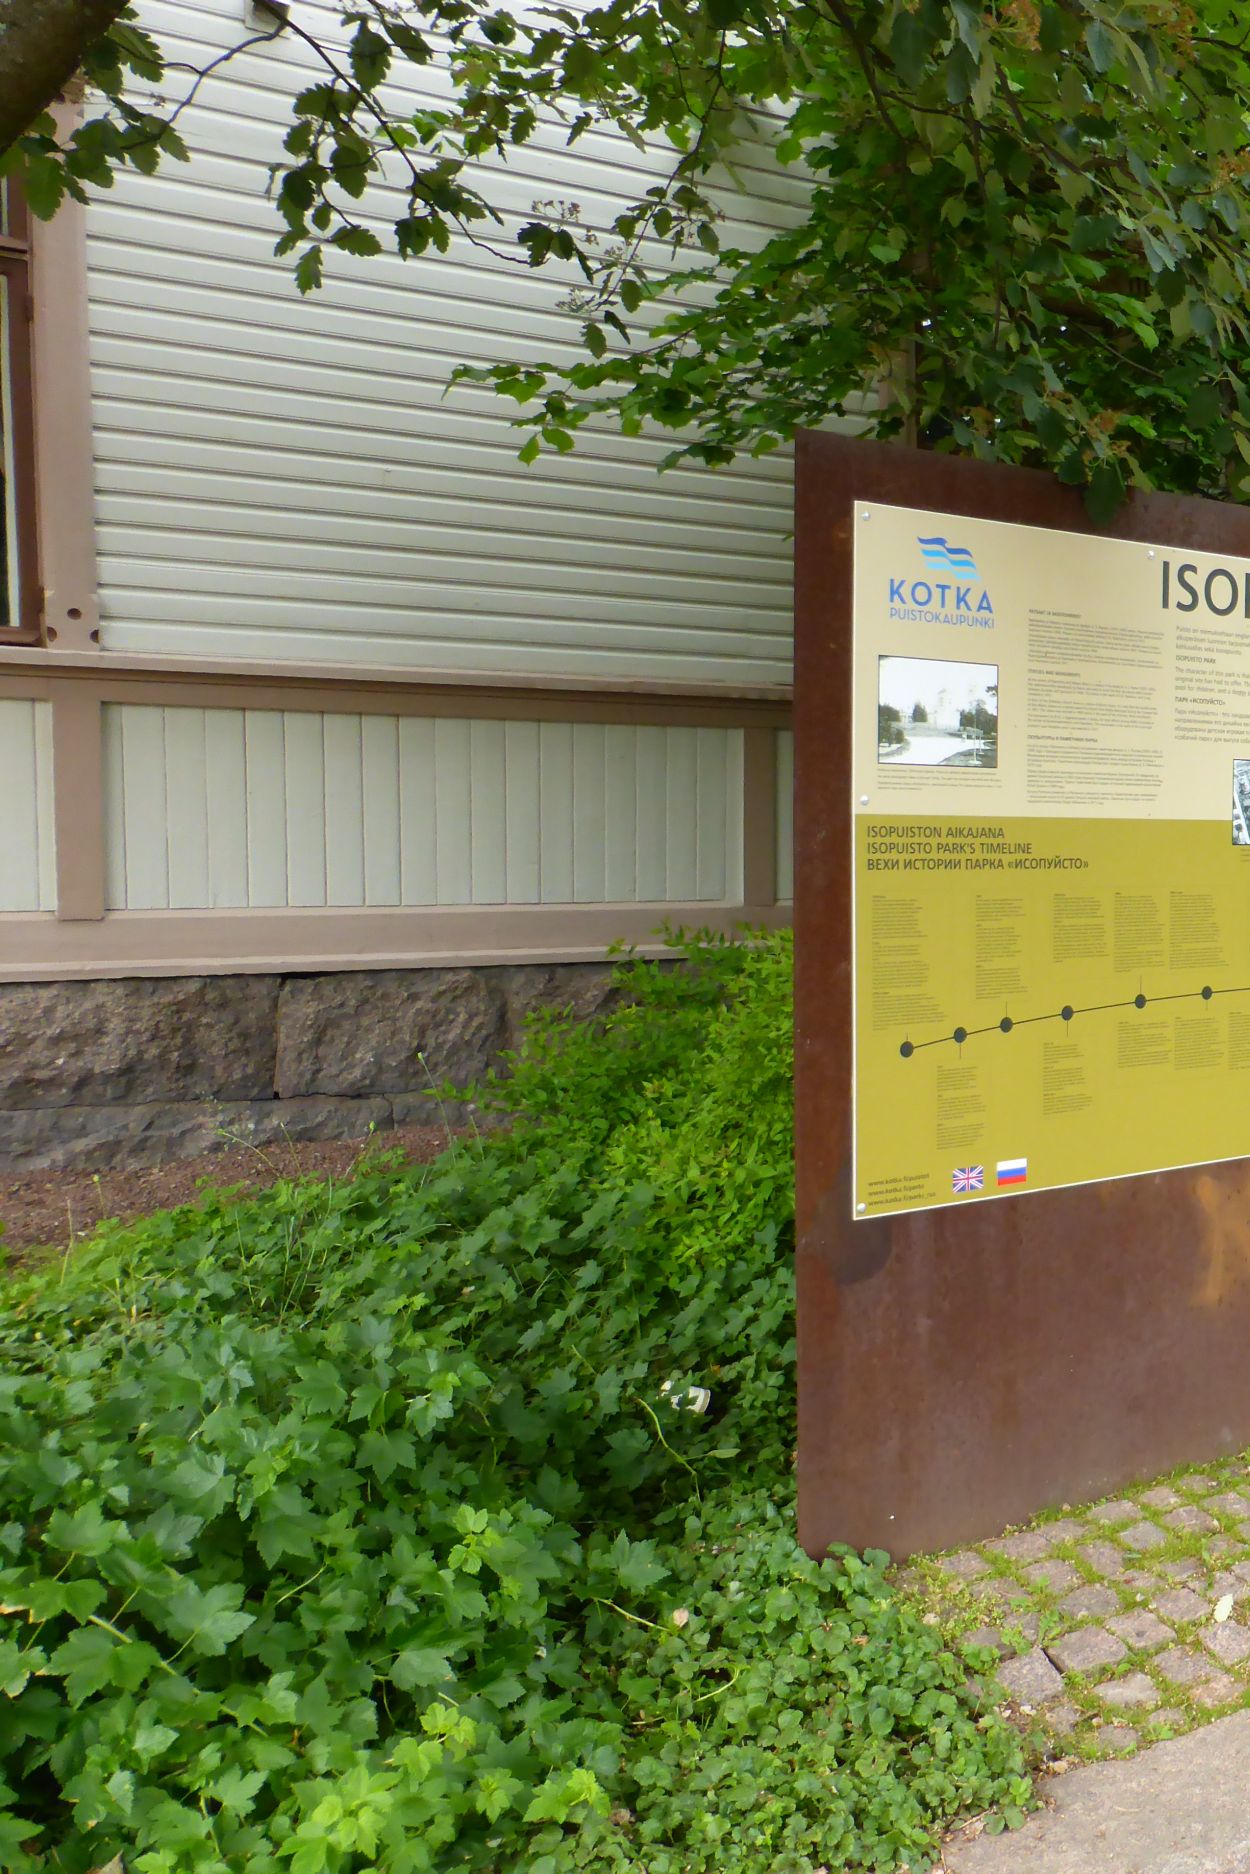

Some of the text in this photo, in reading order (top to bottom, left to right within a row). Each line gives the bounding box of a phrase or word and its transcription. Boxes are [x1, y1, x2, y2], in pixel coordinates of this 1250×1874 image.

[889, 578, 994, 614] KOTKA
[889, 606, 995, 629] PUISTOKAUPUNKI
[867, 825, 1005, 839] ISOPUISTON AIKAJANA
[867, 842, 1032, 855] ISOPUISTO PARK'S TIMELINE
[867, 855, 1088, 871] ВЕХИ ИСТОРИИ ПАРКА «ИСОПУЙСТО»
